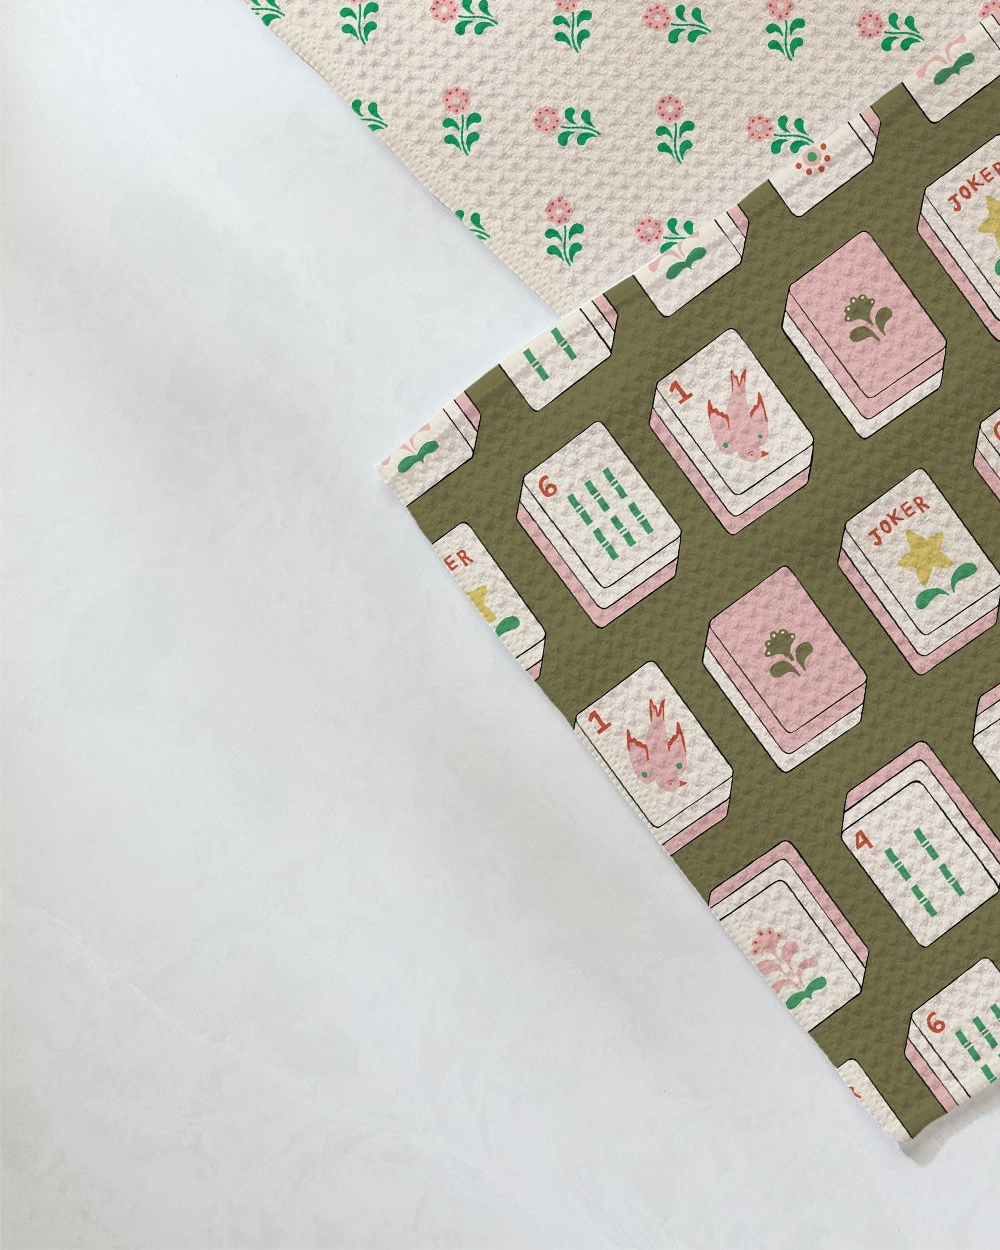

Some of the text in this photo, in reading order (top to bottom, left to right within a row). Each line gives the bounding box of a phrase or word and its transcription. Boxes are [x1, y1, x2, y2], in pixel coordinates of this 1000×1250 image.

[669, 380, 694, 405] 1
[538, 474, 558, 498] 6
[868, 495, 930, 547] JOKER
[587, 710, 613, 735] 1
[854, 829, 874, 850] 4
[926, 1011, 946, 1034] 6
